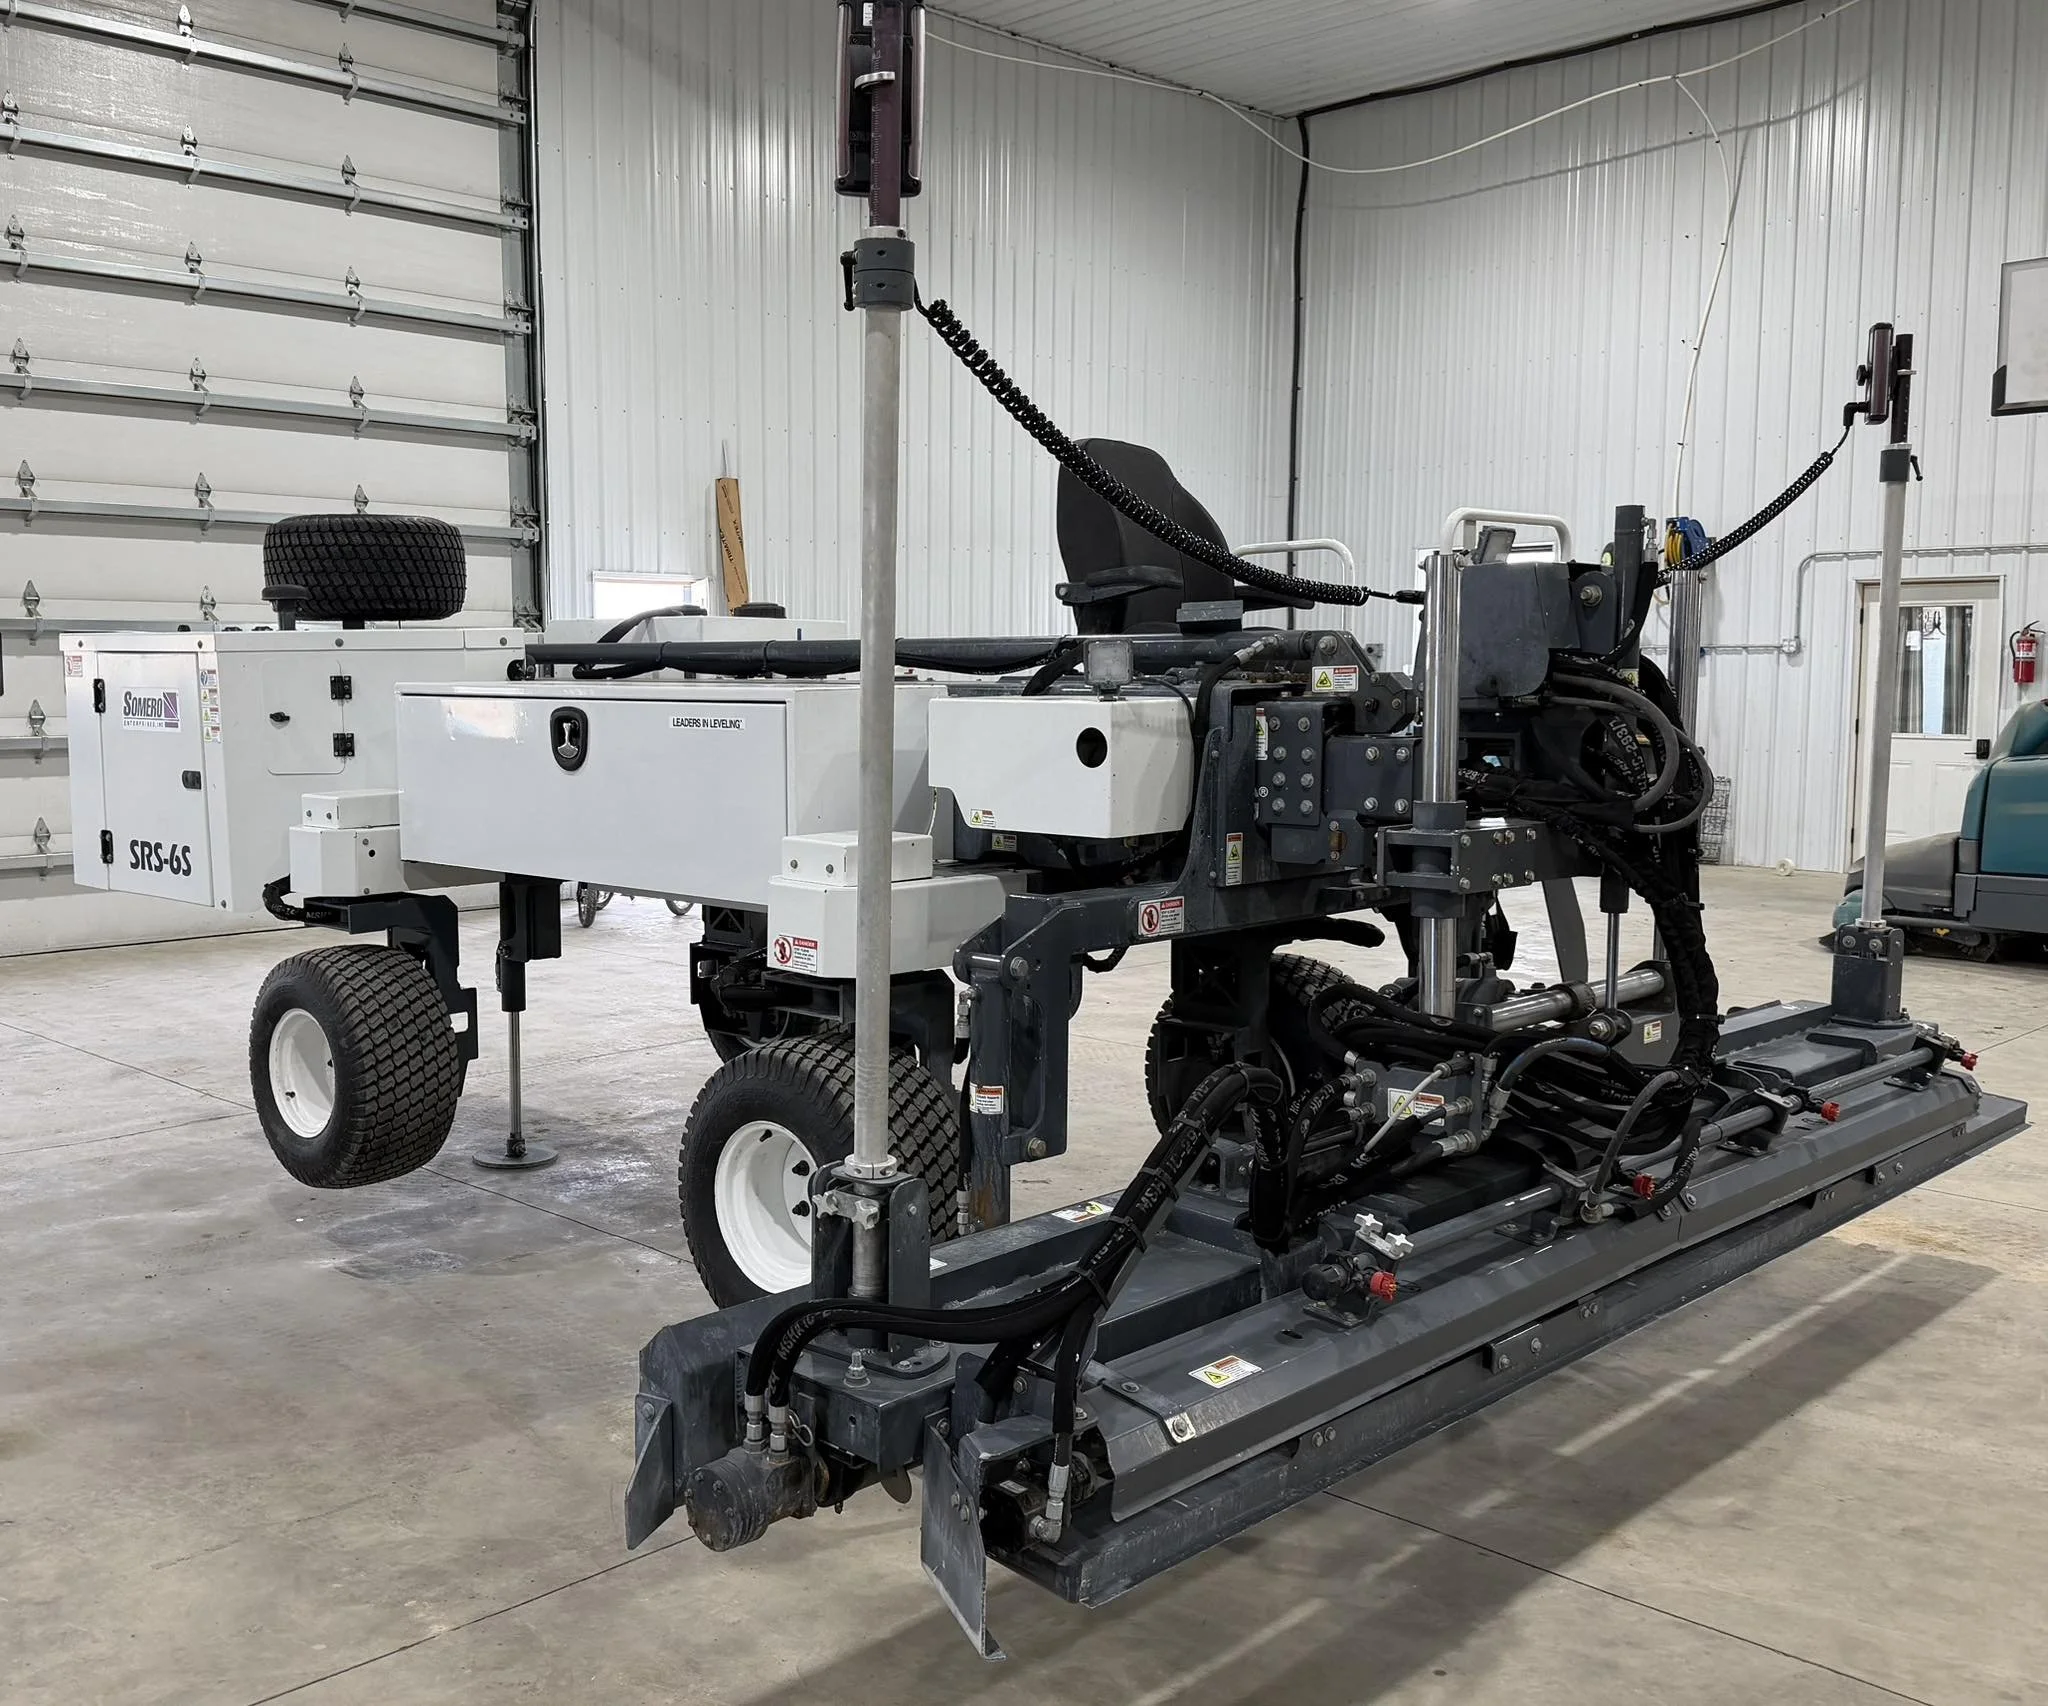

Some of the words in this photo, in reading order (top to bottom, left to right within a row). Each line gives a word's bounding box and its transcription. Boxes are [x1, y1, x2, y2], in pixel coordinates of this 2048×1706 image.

[123, 691, 162, 718] SOMERO
[672, 717, 701, 728] LEADERS
[702, 718, 709, 728] IN
[129, 839, 192, 877] SRS-6S
